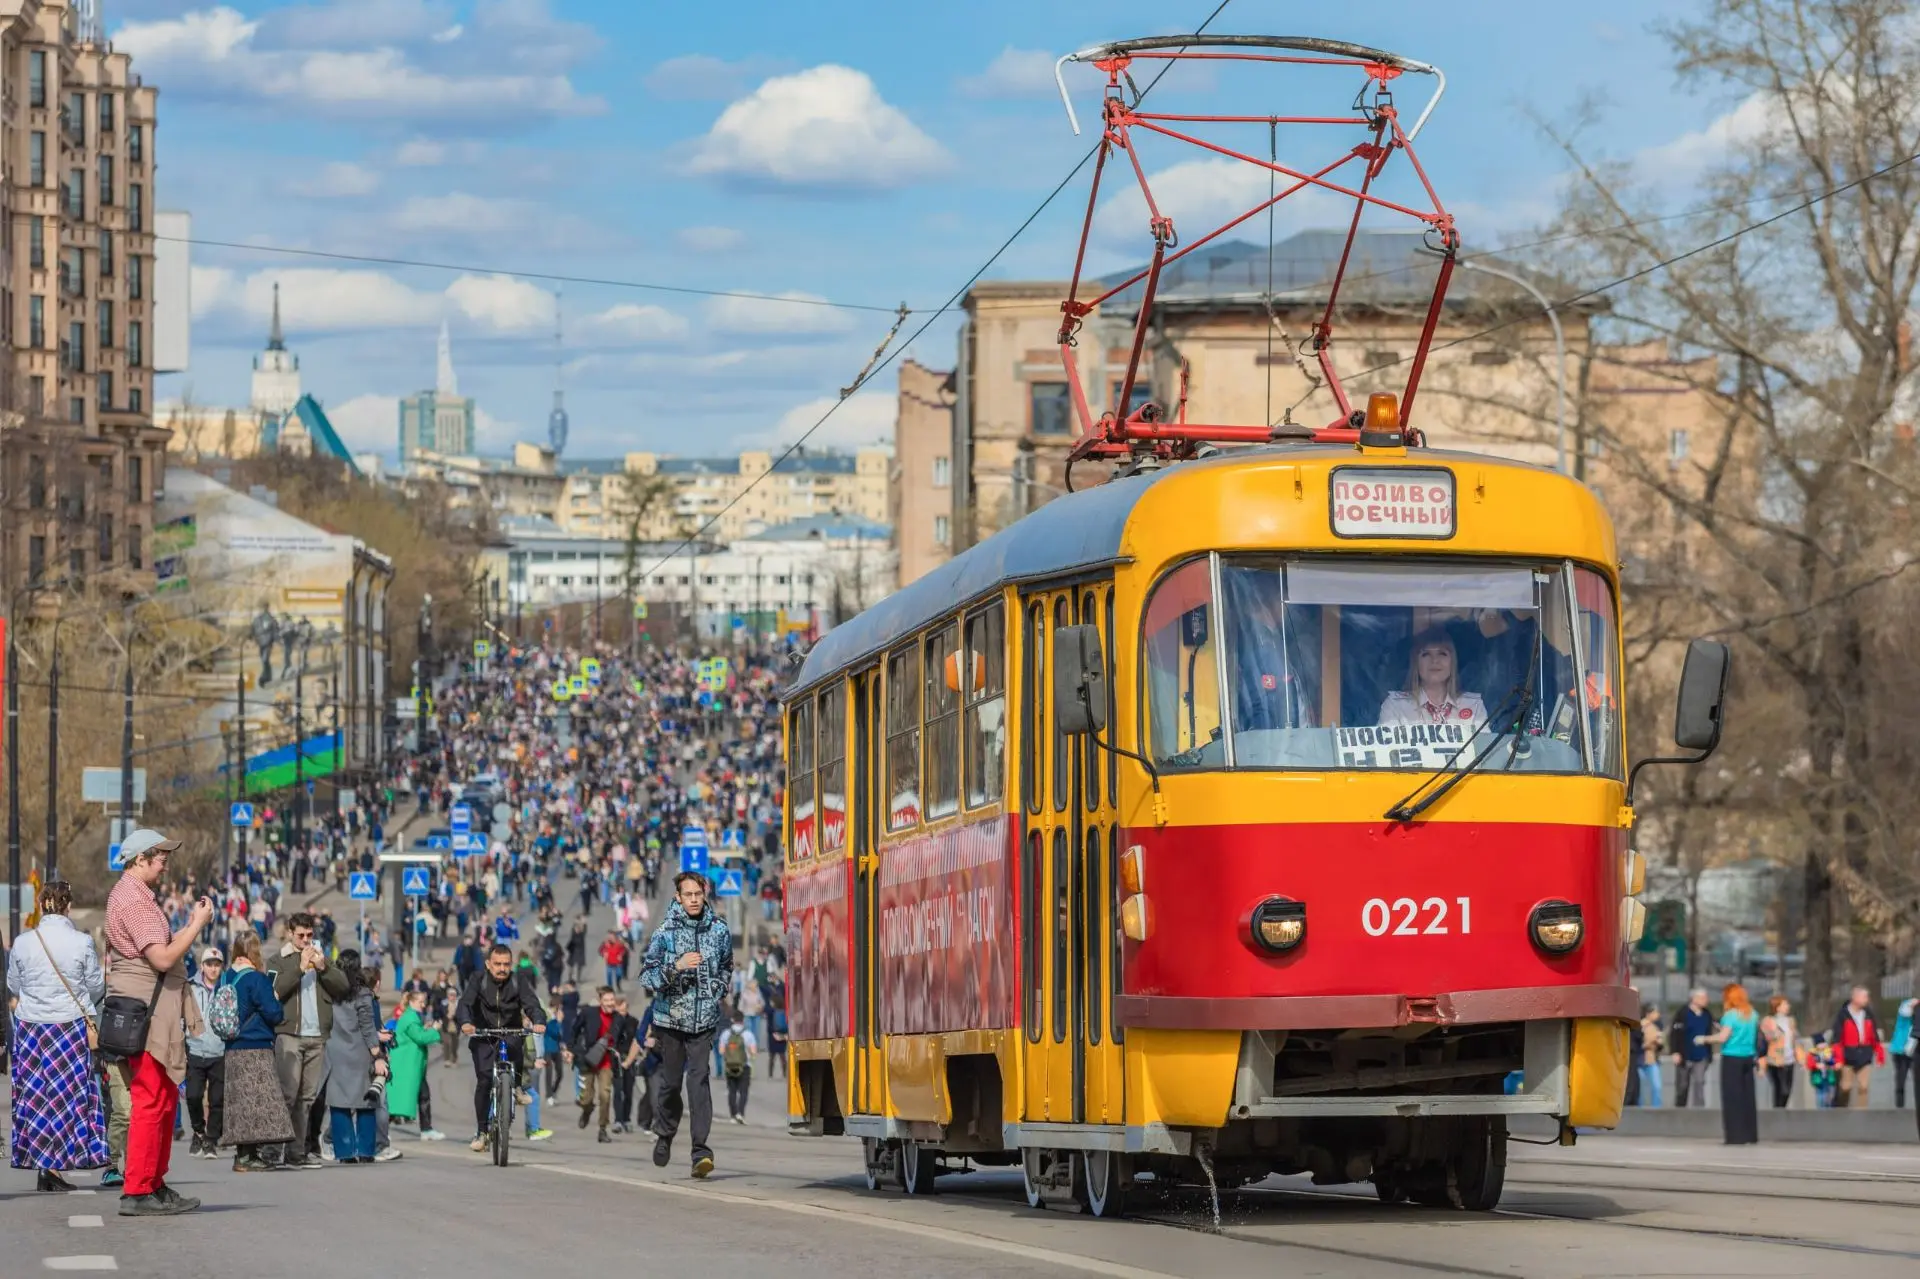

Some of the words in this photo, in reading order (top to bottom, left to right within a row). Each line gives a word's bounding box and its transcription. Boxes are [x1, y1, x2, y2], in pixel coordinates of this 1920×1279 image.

[1335, 482, 1446, 503] ПОЛИВО
[1339, 724, 1463, 747] ПОСАДКИ
[967, 886, 995, 947] ВАГОН
[1361, 896, 1471, 936] 0221
